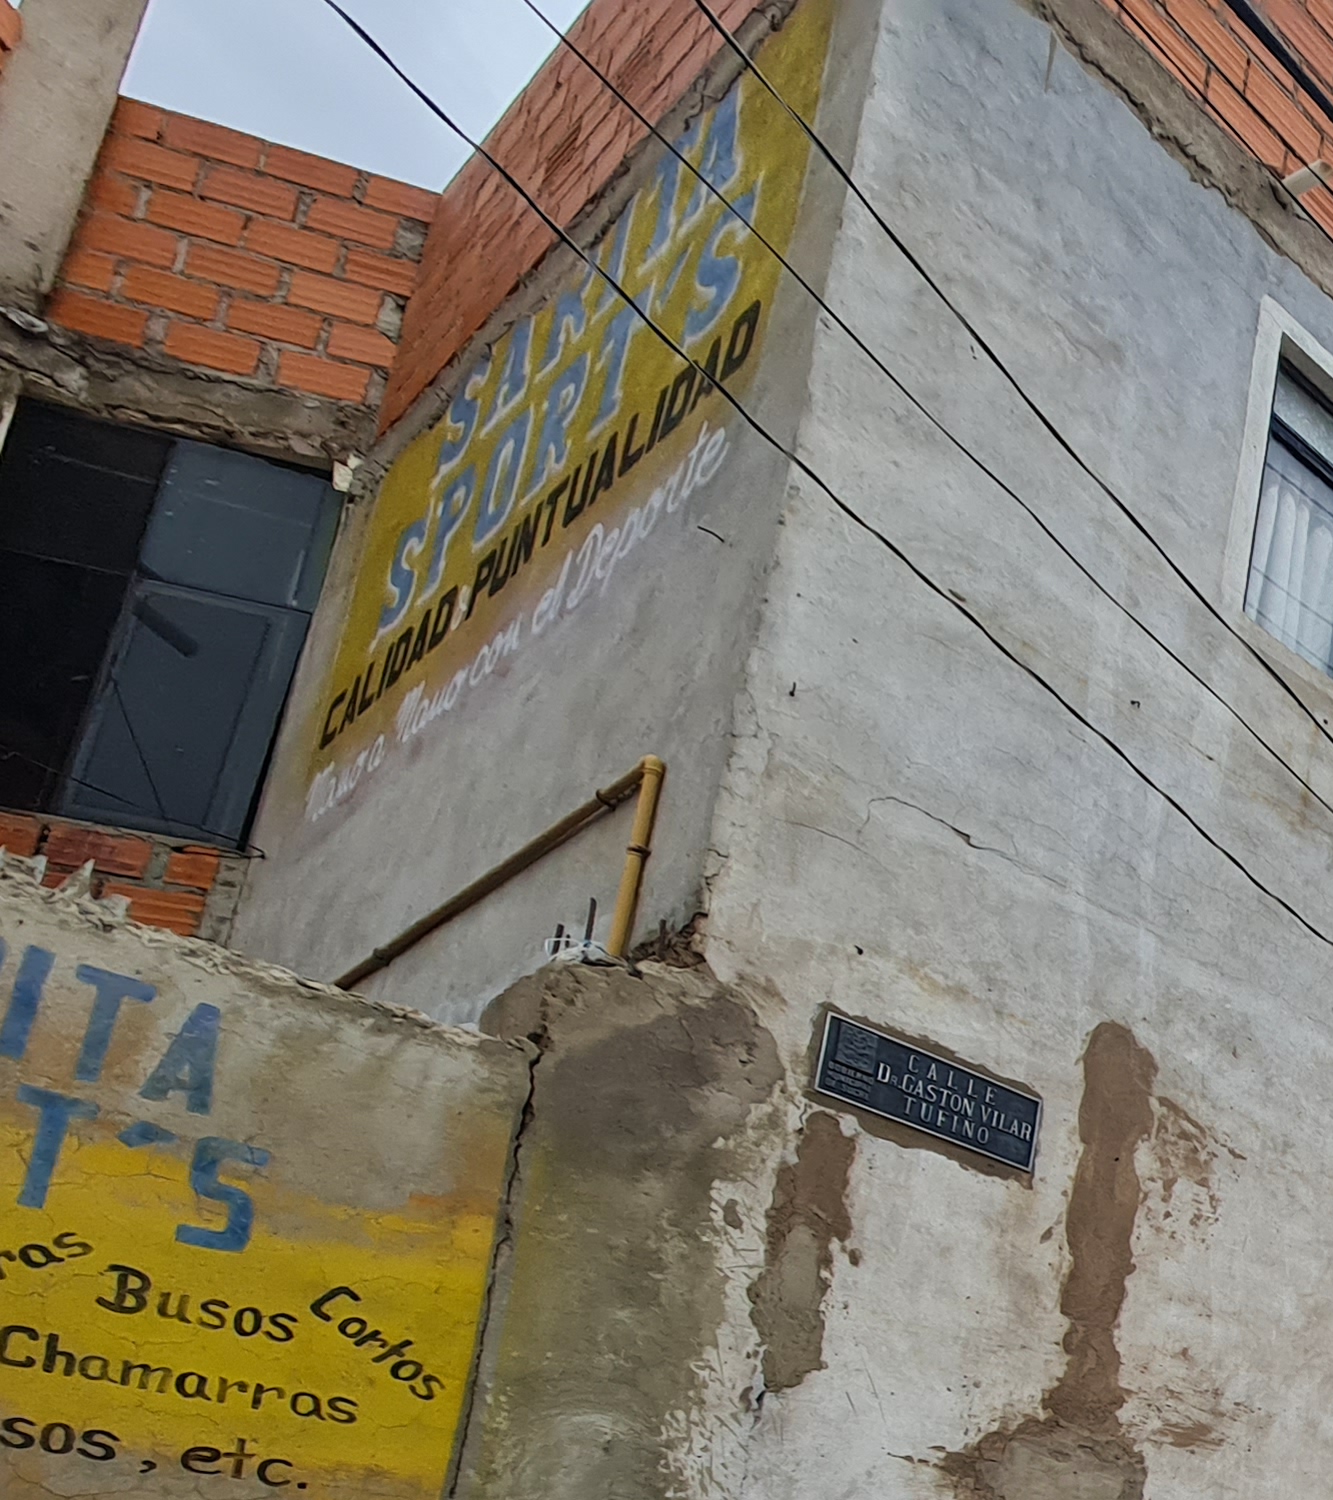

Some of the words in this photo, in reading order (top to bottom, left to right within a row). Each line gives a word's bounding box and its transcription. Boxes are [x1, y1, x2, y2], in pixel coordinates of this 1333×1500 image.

[318, 585, 459, 750] CALIDAD
[465, 299, 762, 621] PUNTUALIDAD
[566, 419, 732, 609] Deporte
[0, 935, 222, 1116] ITA
[908, 1054, 998, 1106] CALLE
[901, 1074, 976, 1117] GASTON
[980, 1105, 1033, 1142] VILAR
[0, 1324, 360, 1425] Chamarras
[95, 1263, 299, 1343] Busos
[309, 1285, 446, 1401] Cortos
[180, 1436, 308, 1490] etc.
